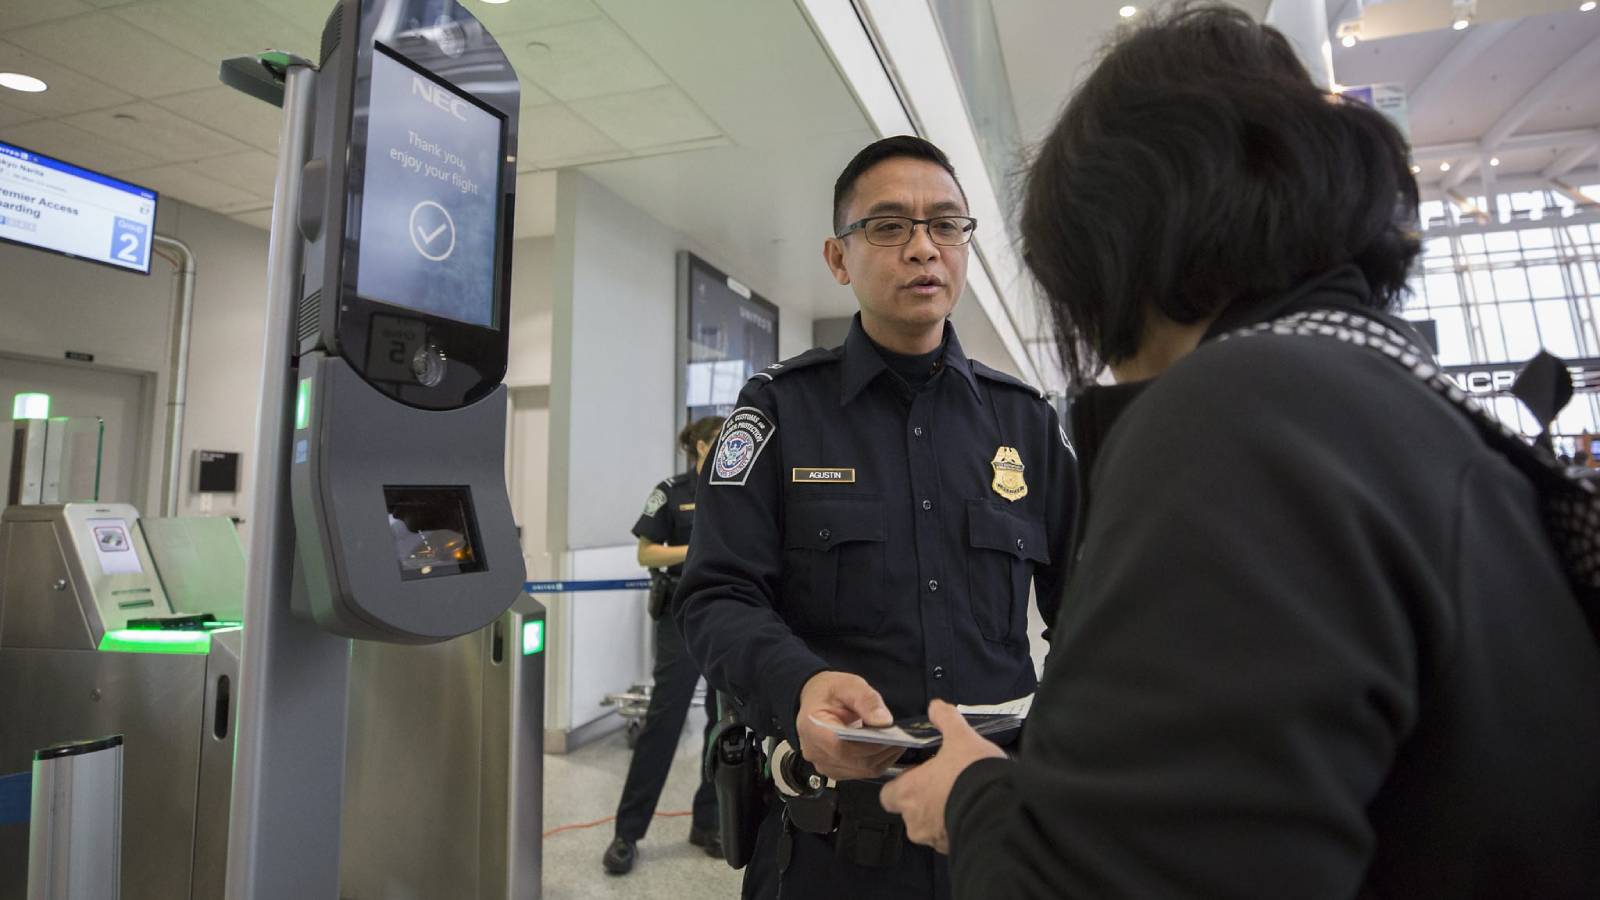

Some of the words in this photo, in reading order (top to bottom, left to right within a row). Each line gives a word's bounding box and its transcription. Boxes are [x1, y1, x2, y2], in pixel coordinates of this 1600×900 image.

[412, 77, 467, 121] NEC
[408, 130, 441, 157] Thank
[443, 150, 467, 171] you,
[390, 148, 422, 172] enjoy
[425, 163, 450, 181] your
[452, 172, 478, 195] flight
[38, 198, 79, 216] Access
[118, 234, 139, 263] 2
[808, 471, 842, 479] AGUSTIN
